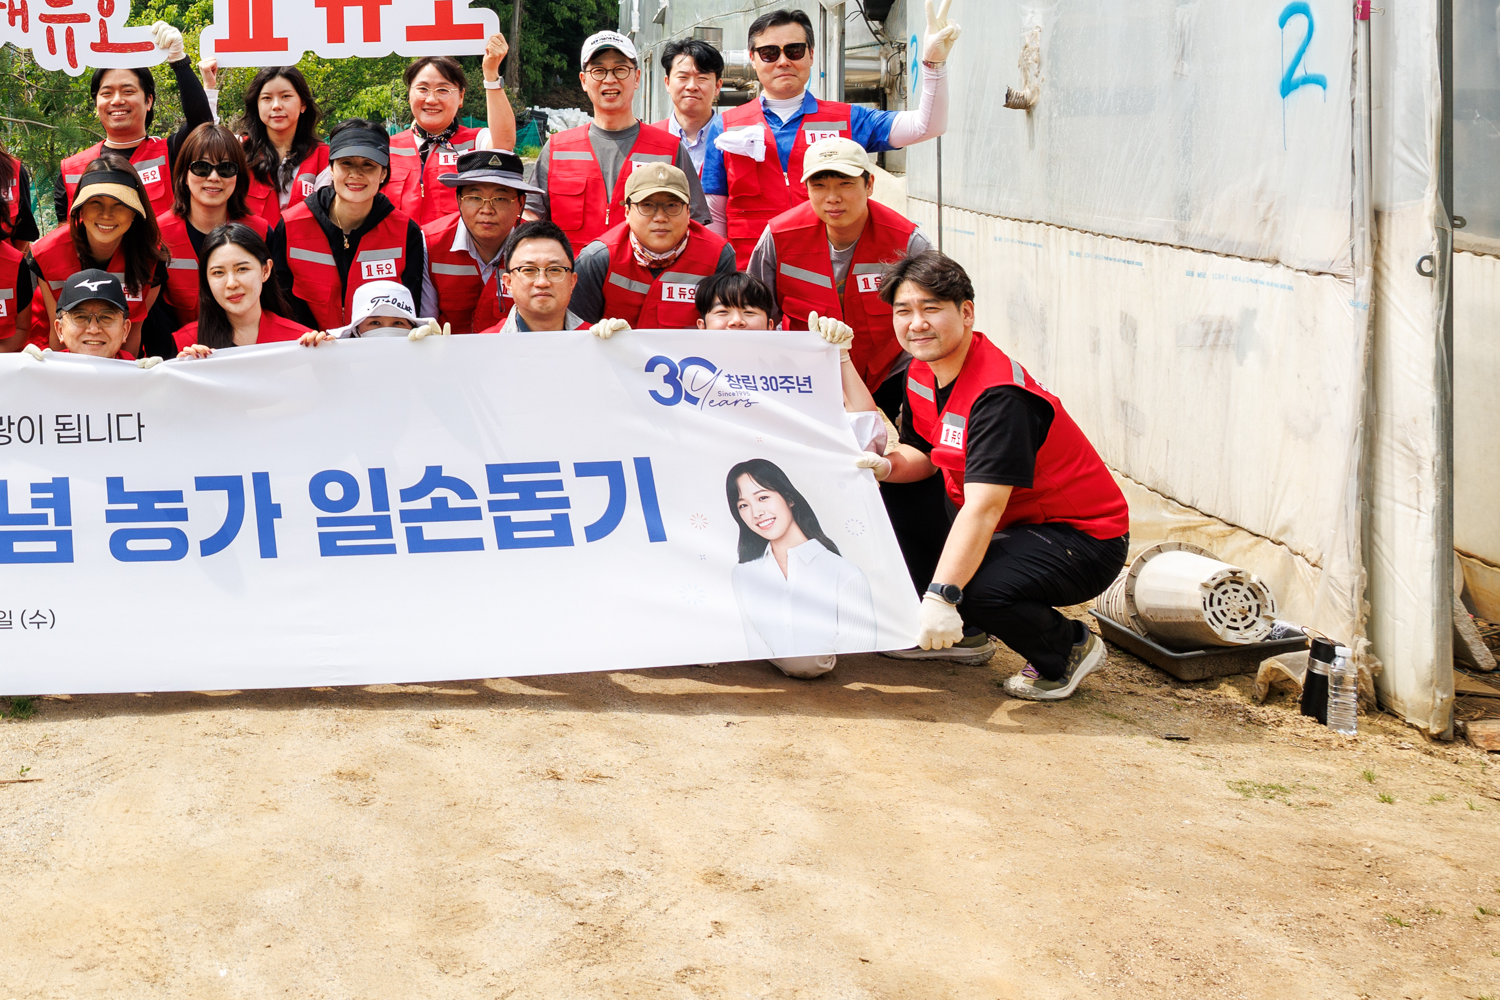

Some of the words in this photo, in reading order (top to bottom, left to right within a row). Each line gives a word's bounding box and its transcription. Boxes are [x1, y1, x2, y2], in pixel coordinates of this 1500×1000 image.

[1278, 1, 1328, 99] 2
[143, 170, 157, 181] 듀오
[376, 263, 393, 275] 듀오
[678, 287, 696, 299] 듀오
[725, 374, 759, 391] 창립
[760, 376, 813, 393] 30주년
[55, 413, 145, 443] 됩니다
[951, 431, 961, 445] 듀오
[105, 472, 282, 562] 농가
[309, 457, 667, 556] 일손돕기
[21, 608, 56, 630] (수)
